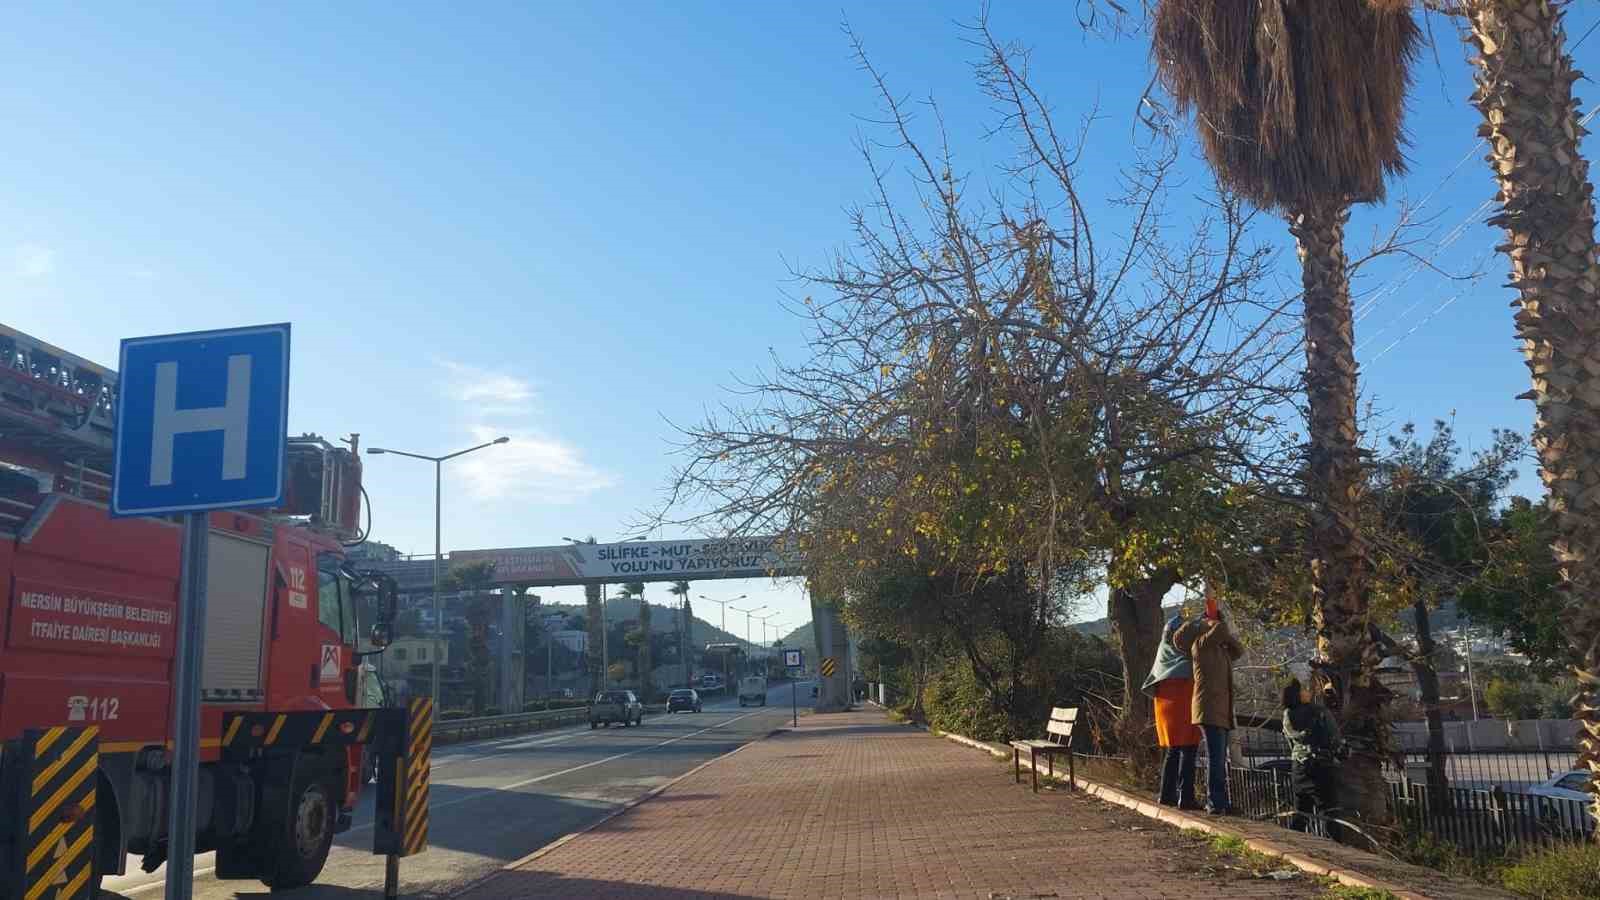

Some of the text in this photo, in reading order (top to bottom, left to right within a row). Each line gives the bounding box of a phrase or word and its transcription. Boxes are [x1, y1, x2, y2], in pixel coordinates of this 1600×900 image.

[150, 354, 252, 486] H
[597, 545, 649, 560] SİLİFKE
[661, 544, 692, 557] MUT
[611, 554, 760, 573] YOLU'NU YAPIYORUZ
[289, 567, 305, 591] 112
[21, 592, 172, 625] MERSİN BÜYÜKŞEHİR BELEDİYESİ
[31, 617, 160, 648] İTFAİYE DAİRESİ BAŞKANLIĞI
[89, 697, 119, 720] 112
